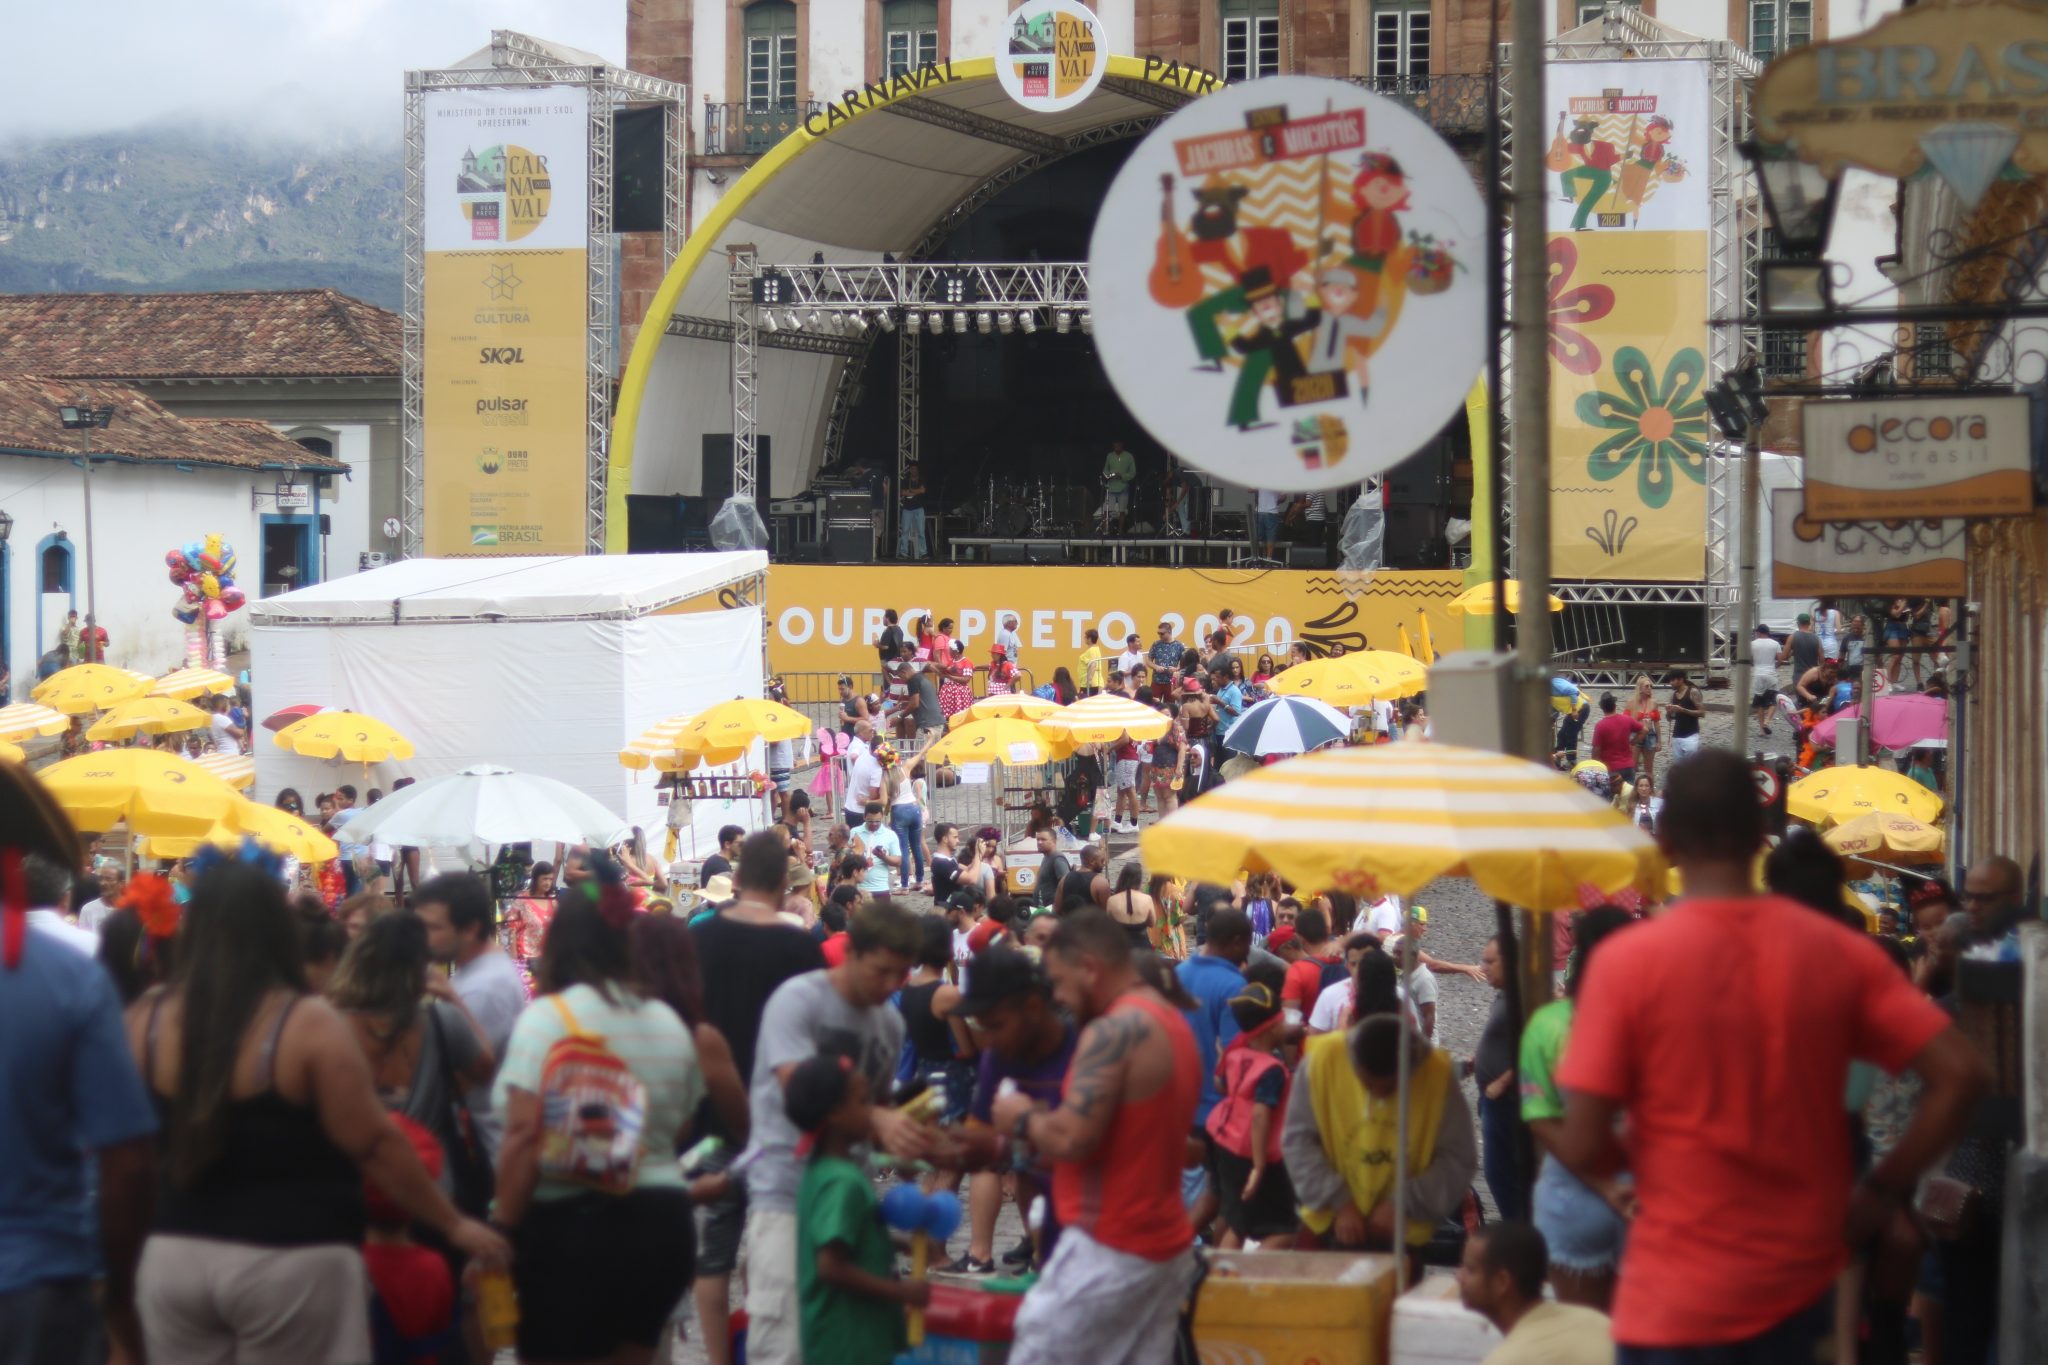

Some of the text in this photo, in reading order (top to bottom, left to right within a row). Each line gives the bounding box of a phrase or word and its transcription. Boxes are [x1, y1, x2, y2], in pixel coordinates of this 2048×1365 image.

[1058, 20, 1093, 38] CAR
[1059, 41, 1080, 58] NA
[1060, 60, 1092, 77] VAL
[1816, 39, 2048, 104] BRAS
[804, 56, 962, 137] CARNAVAL
[554, 105, 574, 114] SKOL
[509, 155, 549, 175] CAR
[510, 177, 535, 196] NA
[509, 197, 548, 218] VAL
[1600, 214, 1621, 226] 2020
[474, 313, 531, 324] CULTURA
[480, 347, 524, 365] SKOL
[476, 396, 528, 415] pulsar
[1847, 413, 1987, 455] decora
[507, 450, 528, 459] OURO
[1886, 445, 1988, 465] brasil
[499, 531, 543, 542] BRASIL
[1160, 612, 1292, 656] 2020
[1888, 823, 1925, 832] SKOL
[1840, 839, 1869, 852] SKOL
